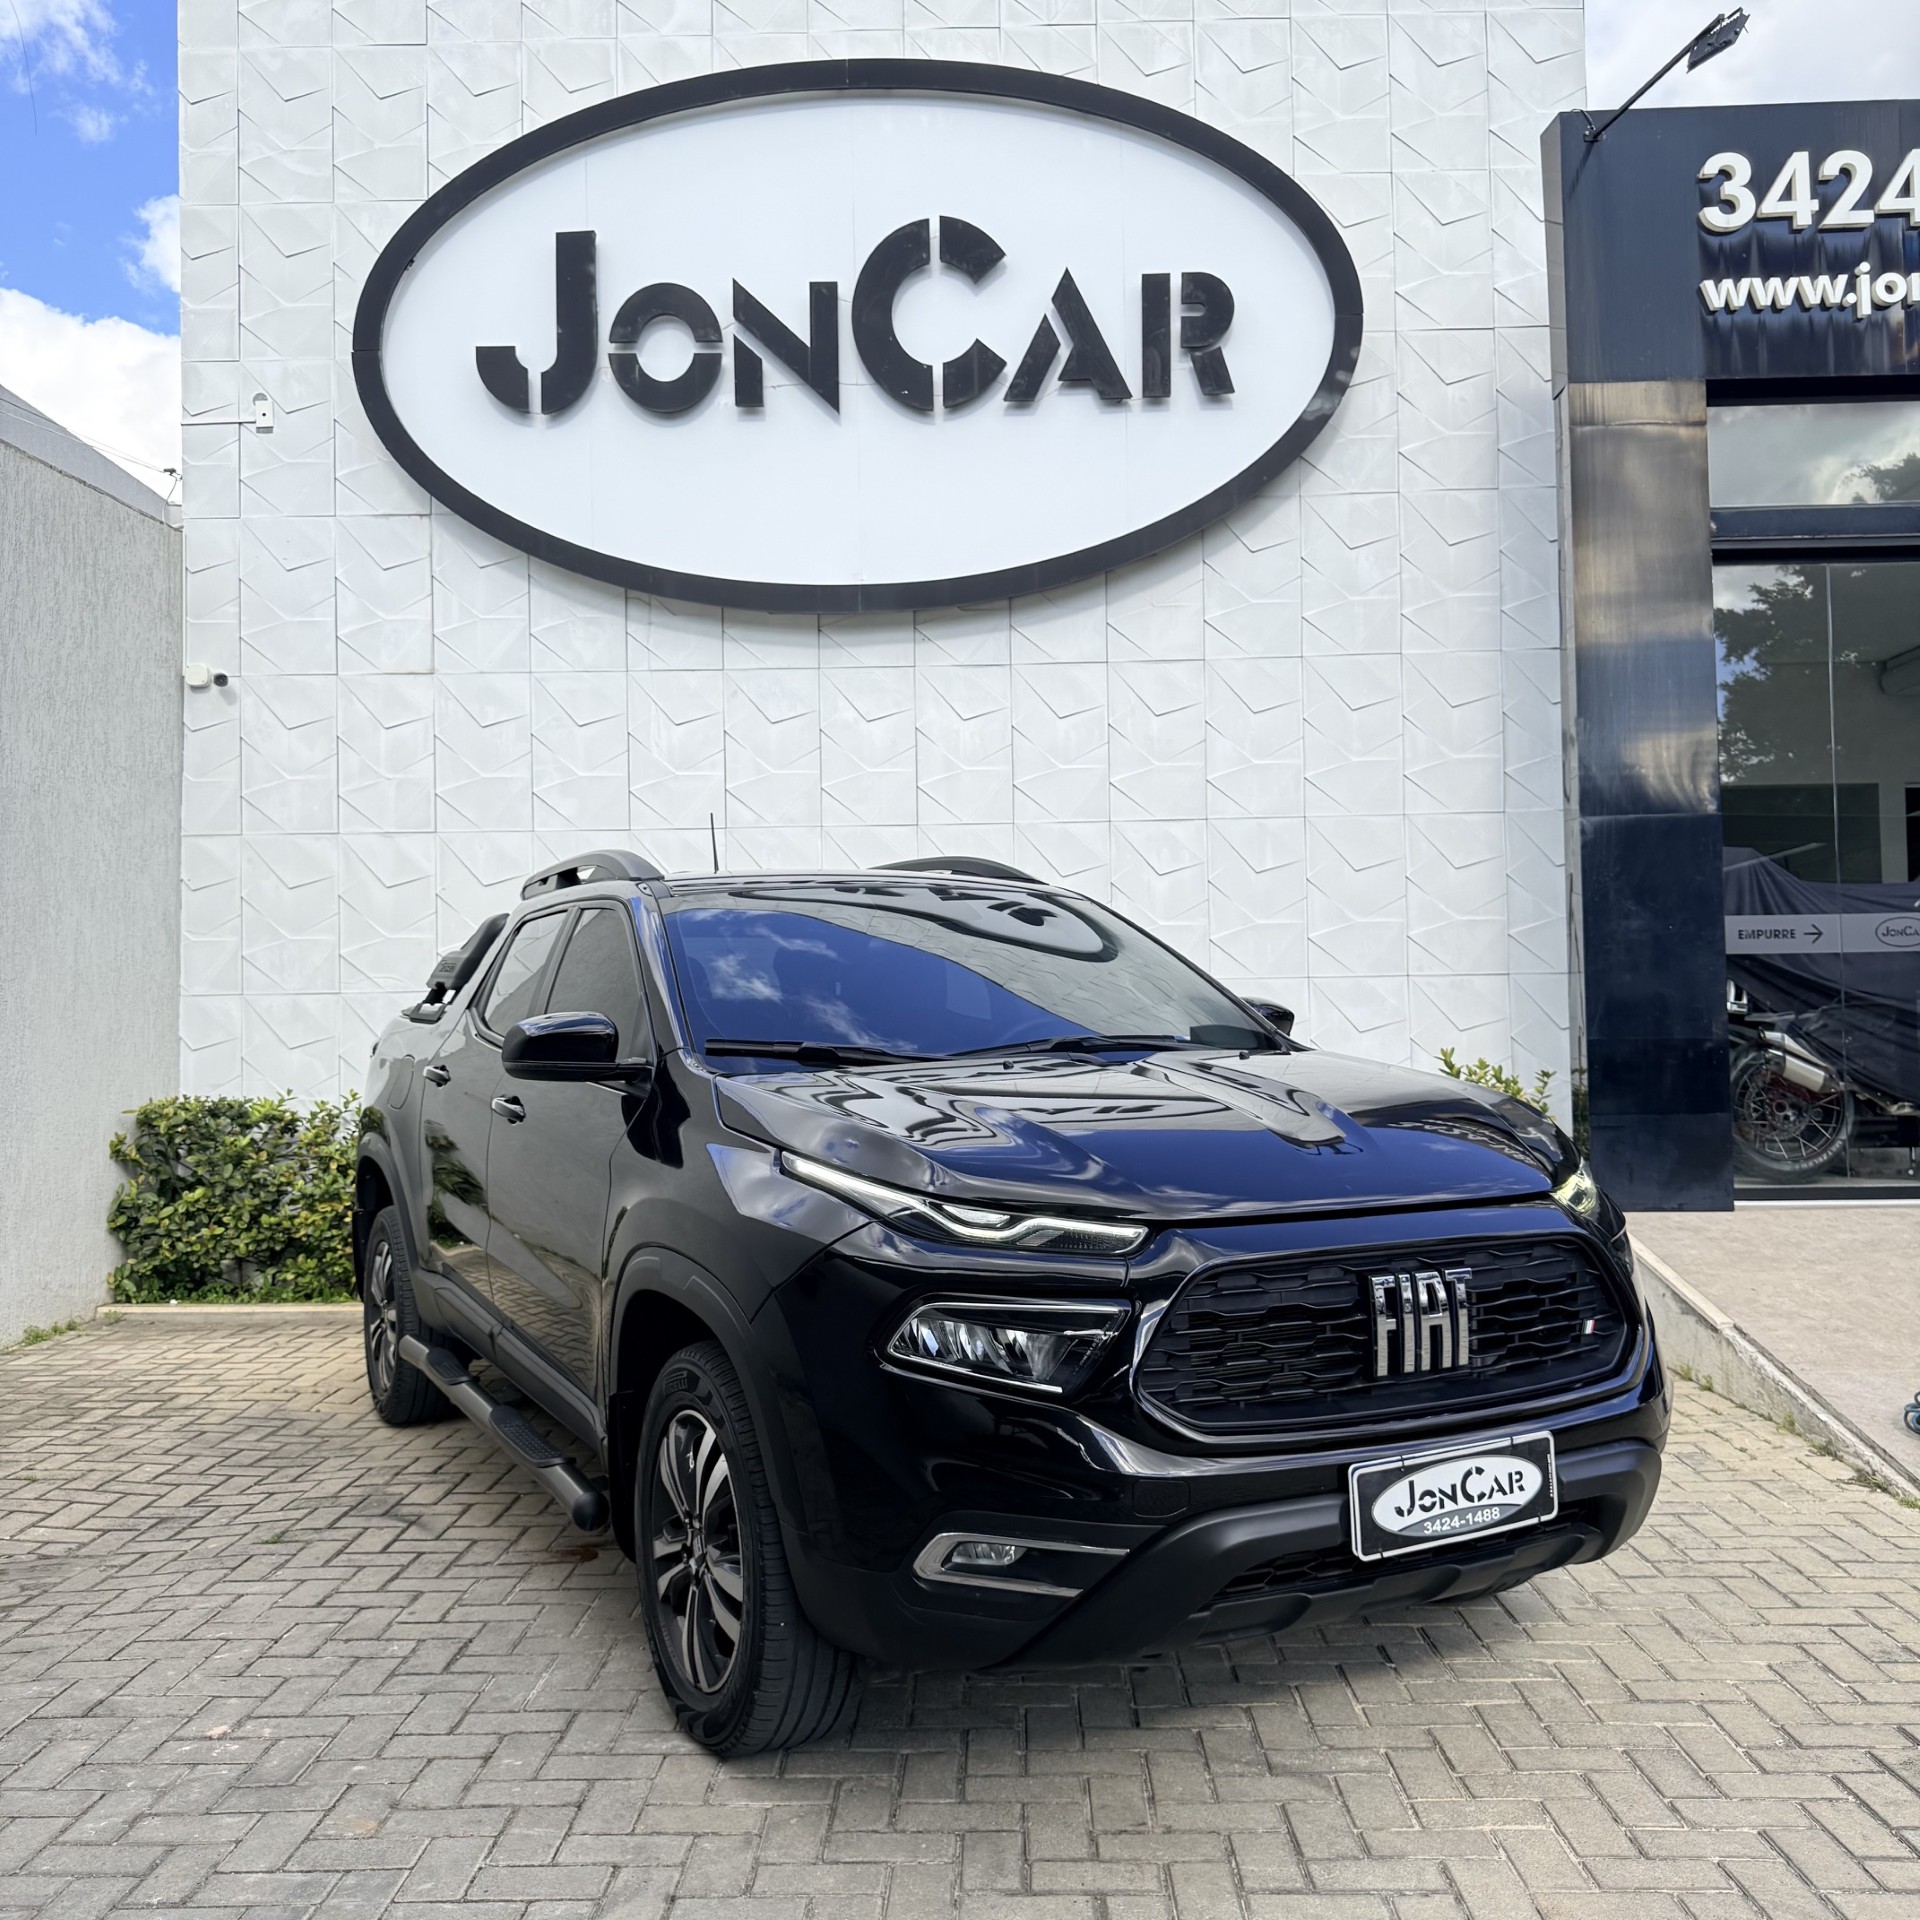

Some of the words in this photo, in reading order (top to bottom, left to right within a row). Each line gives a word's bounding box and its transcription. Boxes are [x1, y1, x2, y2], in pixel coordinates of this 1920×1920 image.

[1699, 149, 1920, 233] 3424
[475, 215, 1235, 416] JONCAR
[1738, 928, 1796, 940] EMPURRE
[1881, 925, 1920, 937] JONCA
[1371, 1267, 1473, 1377] FIAT
[1423, 1507, 1500, 1534] 3424-1488
